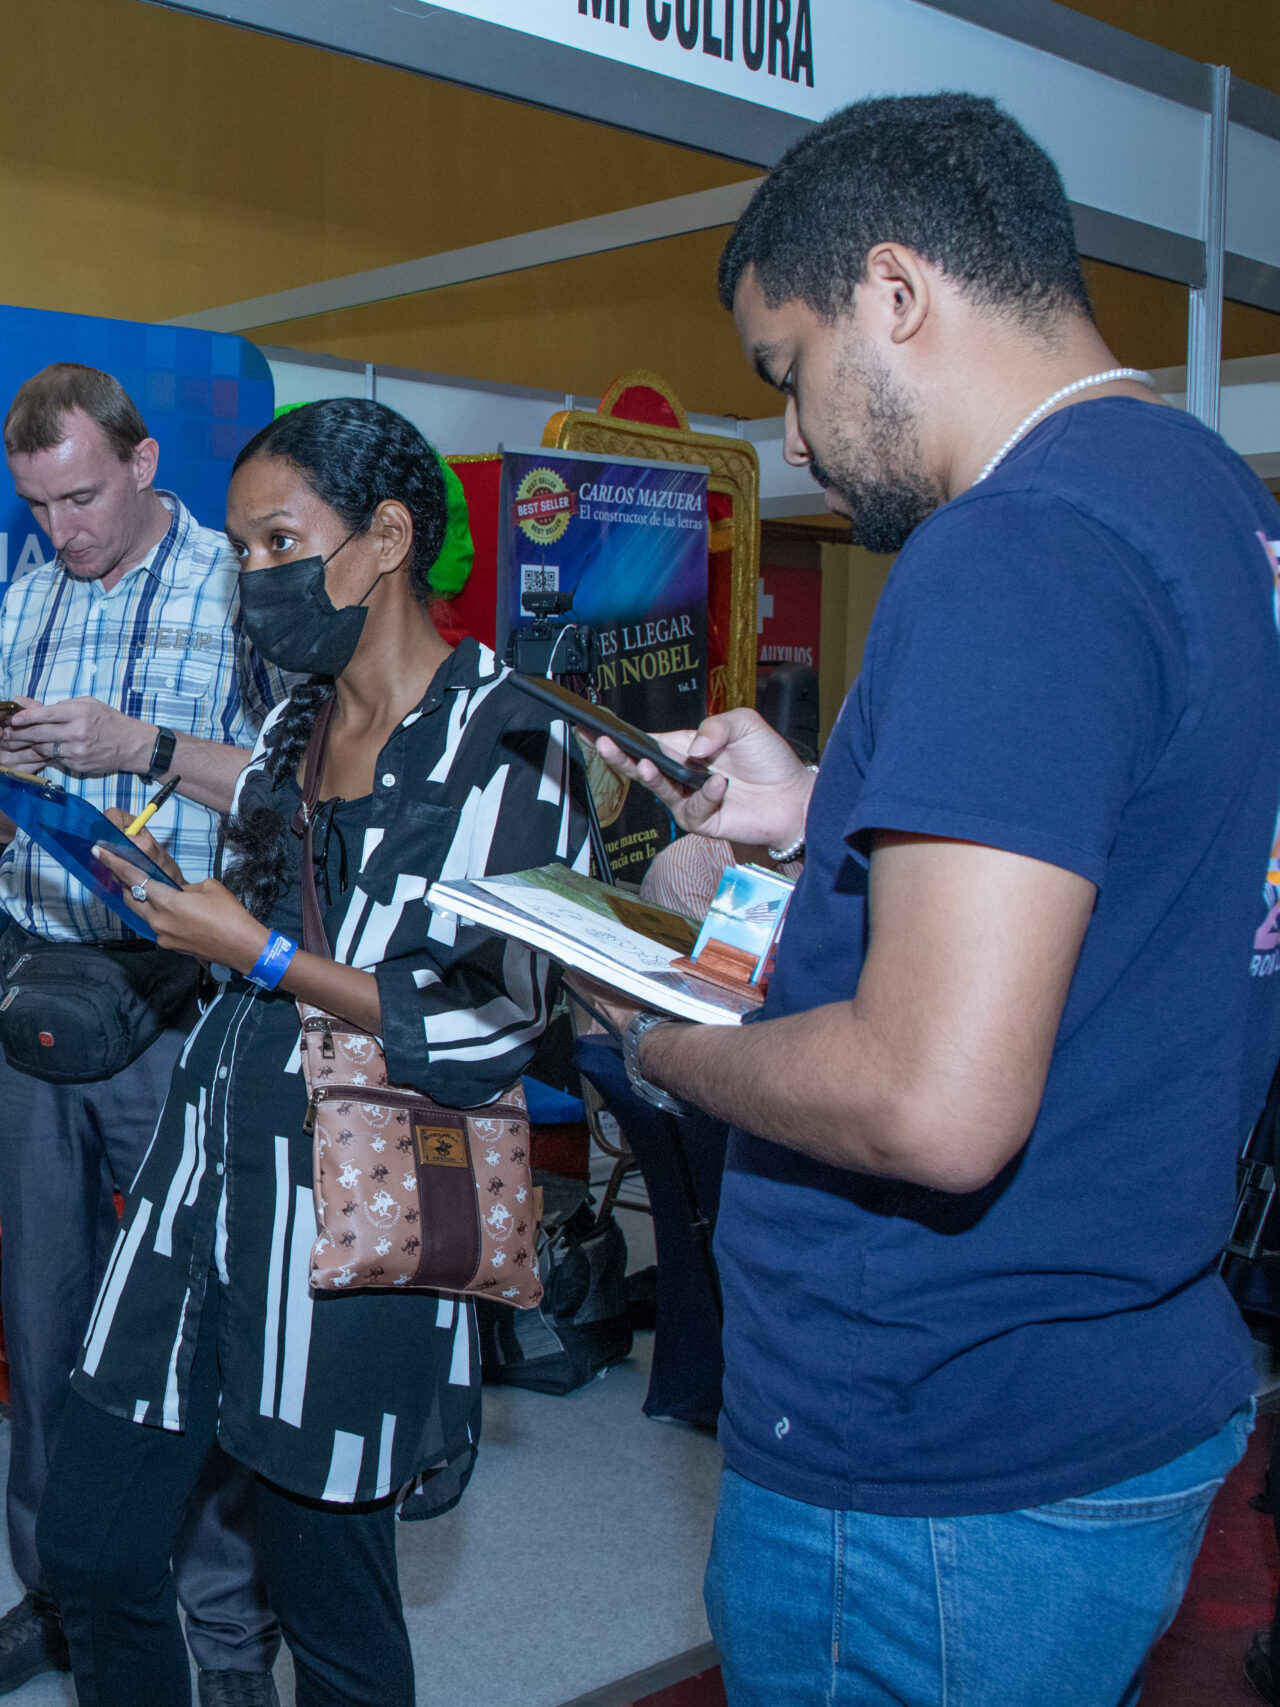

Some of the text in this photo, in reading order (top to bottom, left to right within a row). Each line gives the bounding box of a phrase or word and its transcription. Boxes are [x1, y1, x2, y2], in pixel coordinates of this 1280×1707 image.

[517, 497, 570, 517] BEST SELLER
[579, 483, 702, 512] CARLOS MAZUERA
[580, 505, 703, 530] El constructor de las letras
[599, 614, 695, 657] ES LLEGAR
[622, 643, 700, 686] NOBEL
[620, 829, 658, 848] marcan
